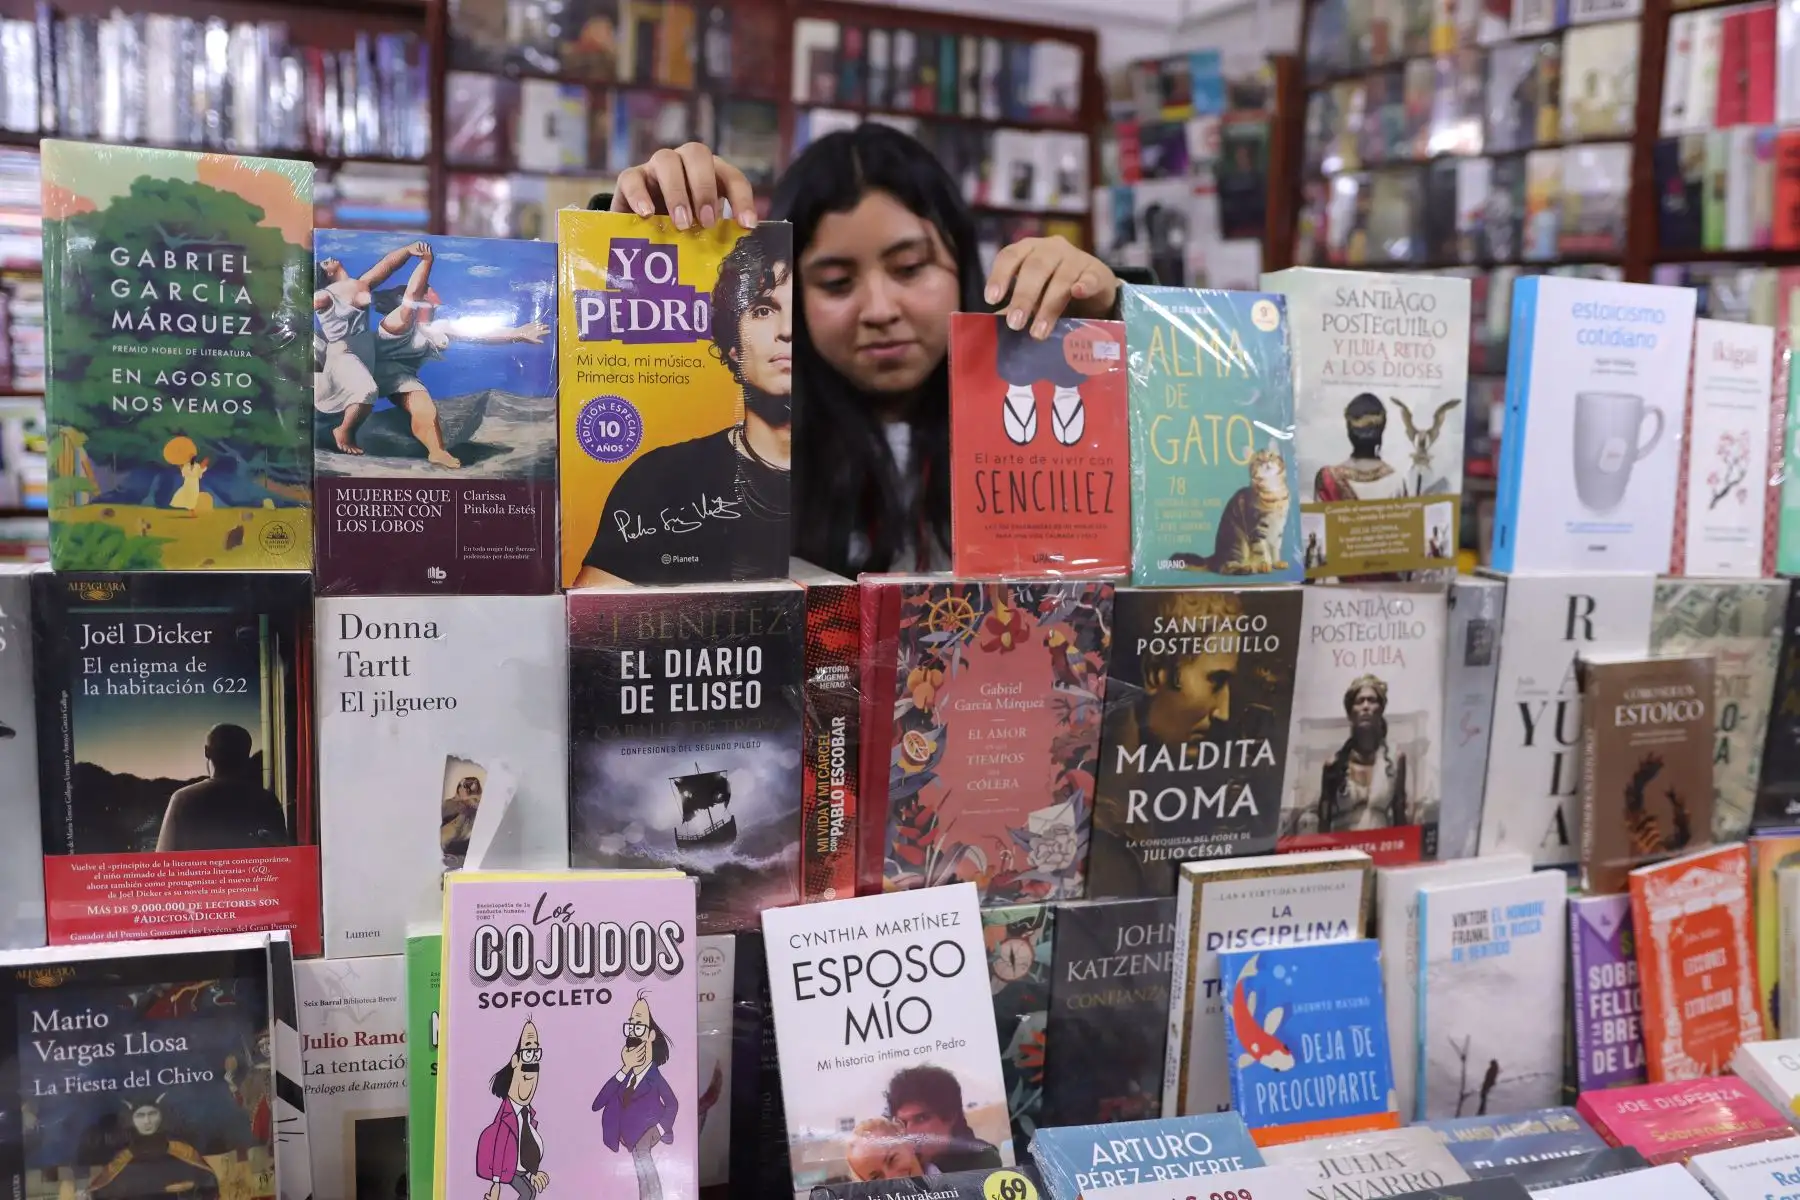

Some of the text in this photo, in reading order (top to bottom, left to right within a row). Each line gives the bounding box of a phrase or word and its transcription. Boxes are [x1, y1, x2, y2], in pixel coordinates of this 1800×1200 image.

[110, 247, 252, 273] GABRIEL
[611, 248, 676, 286] YO,
[110, 279, 252, 304] GARCÍA
[1336, 286, 1436, 314] SANTIAGO
[112, 307, 252, 335] MÁRQUEZ
[581, 298, 708, 334] PEDRO
[1572, 301, 1665, 324] estoicismo
[1322, 313, 1447, 339] POSTEGUILLO
[1577, 326, 1657, 349] cotidiano
[112, 345, 252, 358] PREMIO NOBEL DE LITERATURA
[577, 354, 705, 368] Mi vida, mi música.
[112, 368, 252, 388] EN AGOSTO
[577, 371, 689, 385] Primeras historias
[1322, 360, 1443, 379] A LOS DIOSES
[113, 396, 252, 415] NOS VEMOS
[1165, 383, 1189, 409] DE
[582, 402, 636, 444] EDICIÓN ESPECIAL
[599, 421, 620, 437] 10
[596, 443, 623, 453] AÑOS
[1150, 414, 1254, 466] GATO
[975, 453, 1113, 466] El arte de vivir con
[336, 488, 450, 504] MUJERES QUE
[463, 490, 506, 501] Clarissa
[976, 470, 1114, 514] SENCILLEZ
[336, 504, 442, 517] CORREN CON
[463, 504, 536, 515] Pinkola Estés
[336, 519, 424, 533] LOS LOBOS
[673, 555, 699, 563] Planeta
[1157, 560, 1185, 569] URANO
[68, 581, 126, 593] ALFAGUARA
[1323, 596, 1414, 619] SANTIAGO
[338, 613, 439, 640] Donna
[1153, 615, 1267, 634] SANTIAGO
[1310, 621, 1426, 644] POSTEGUILLO
[80, 623, 212, 650] Joël Dicker
[1137, 635, 1280, 656] POSTEGUILLO
[83, 656, 207, 678] El enigma de
[338, 651, 412, 678] Tartt
[621, 646, 762, 680] EL DIARIO
[1362, 645, 1406, 669] JULIA
[815, 665, 850, 675] VICTORIA
[84, 677, 248, 695] la habitación 622
[819, 681, 846, 690] HENAO
[980, 682, 1022, 696] Gabriel
[340, 690, 457, 717] El jilguero
[621, 680, 762, 715] DE ELISEO
[955, 698, 1045, 713] García Márquez
[1614, 699, 1705, 727] ESTOICO
[968, 727, 1027, 740] EL AMOR
[621, 741, 761, 756] CONFESIONES DEL SEGUNDO PILOTO
[831, 716, 846, 785] ESCOBAR
[966, 753, 1024, 765] TIEMPOS
[1116, 738, 1276, 774] MALDITA
[967, 778, 1019, 790] CÓLERA
[831, 789, 844, 837] PABLO
[1126, 783, 1260, 824] ROMA
[1143, 843, 1233, 863] JULIO CÉSAR
[87, 898, 279, 915] MÁS DE 9.000.000 DE LECTORES SON
[532, 891, 575, 926] Los
[1272, 905, 1293, 919] LA
[1452, 909, 1488, 928] VIKTOR
[345, 930, 380, 940] Lumen
[790, 912, 961, 949] CYNTHIA MARTÍNEZ
[1207, 919, 1349, 951] DISCIPLINA
[1452, 926, 1490, 946] FRANKL
[473, 920, 685, 983] COJUDOS
[793, 940, 965, 1001] ESPOSO
[320, 999, 341, 1008] Barral
[343, 997, 376, 1005] Biblioteca
[378, 996, 397, 1004] Breve
[478, 988, 613, 1009] SOFOCLETO
[32, 1008, 109, 1033] Mario
[845, 989, 932, 1045] MÍO
[33, 1032, 188, 1066] Vargas Llosa
[302, 1033, 348, 1052] Julio
[1301, 1025, 1376, 1064] DEJA DE
[817, 1038, 966, 1072] Mi historia íntima con Pedro
[303, 1059, 324, 1076] La
[34, 1067, 213, 1096] La Fiesta del Chivo
[304, 1078, 399, 1096] Prólogos de Ramón
[1256, 1071, 1380, 1116] PREOCUPARTE
[1617, 1088, 1746, 1114] JOE DISPENZA
[1092, 1131, 1212, 1167] ARTURO
[1318, 1151, 1406, 1180] JULIA
[886, 1187, 960, 1200] Murakami
[1307, 1168, 1444, 1200] NAVARRO
